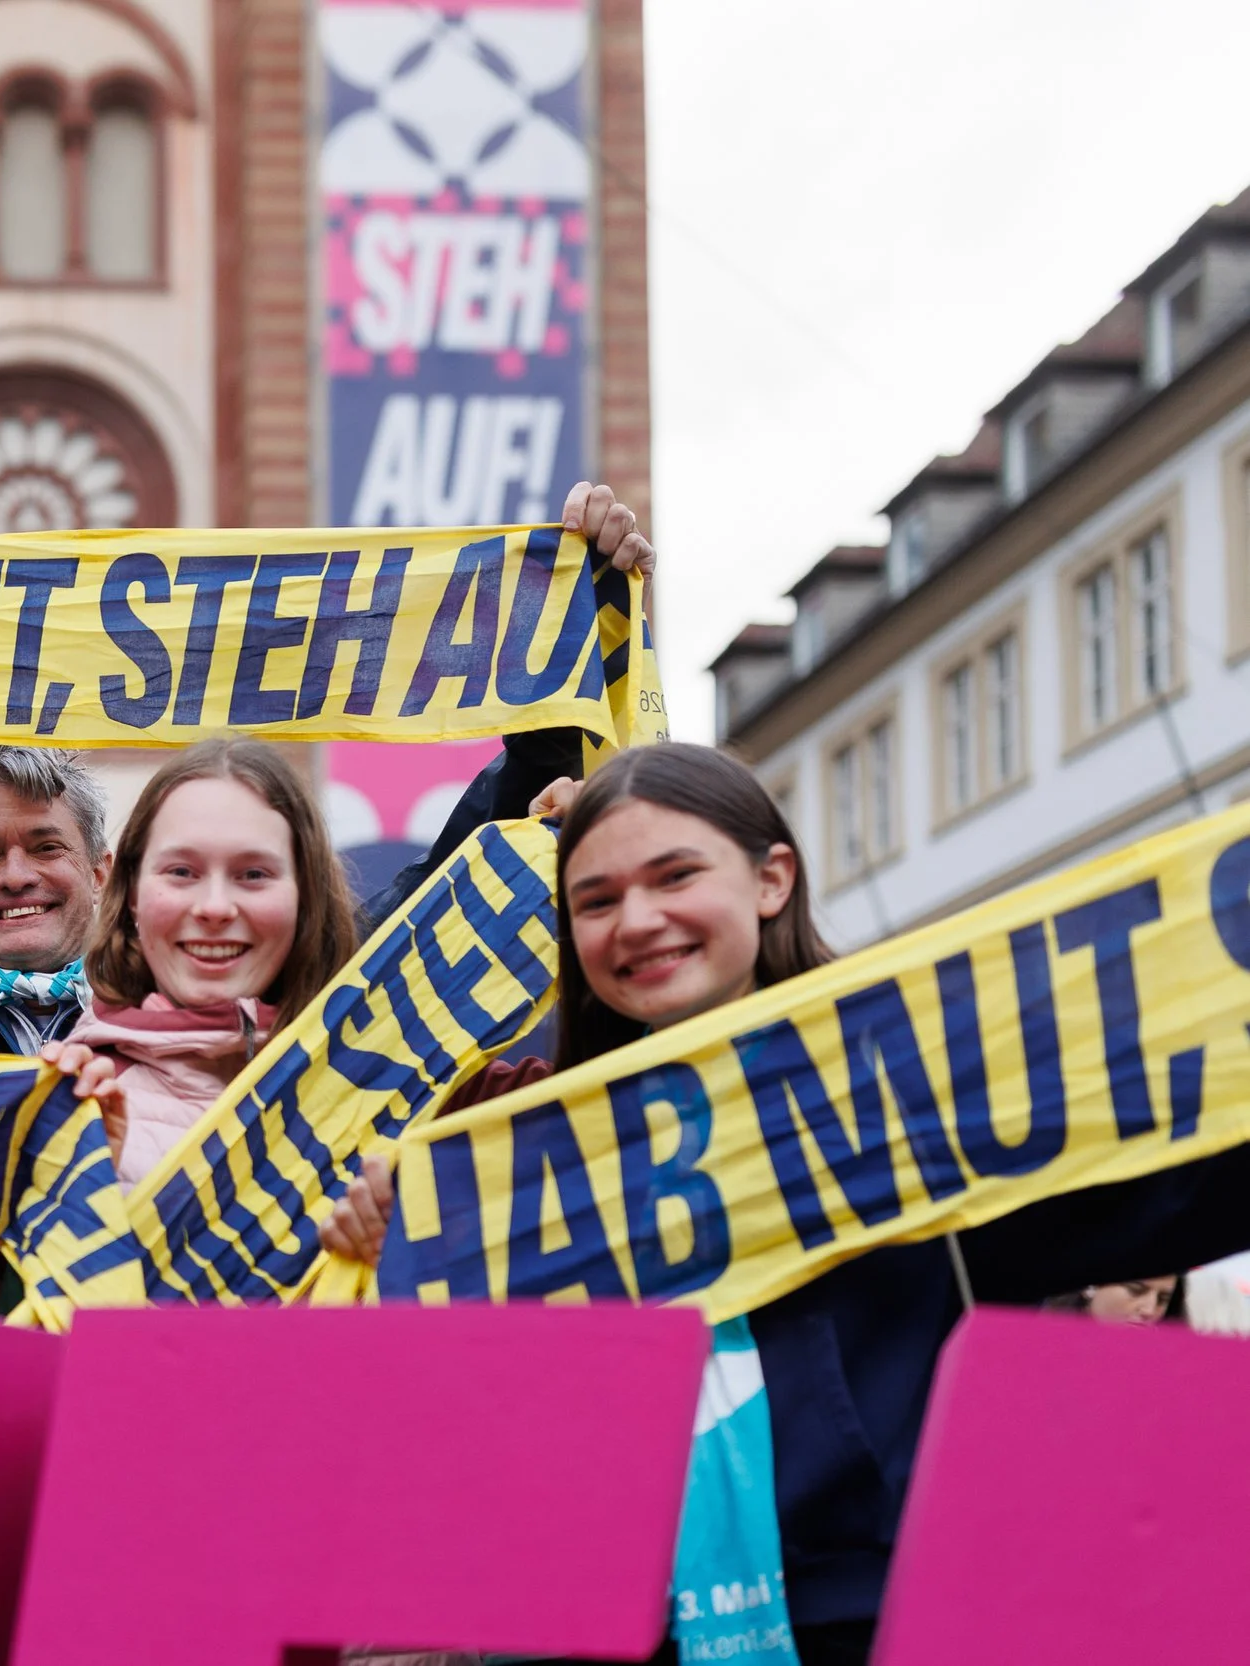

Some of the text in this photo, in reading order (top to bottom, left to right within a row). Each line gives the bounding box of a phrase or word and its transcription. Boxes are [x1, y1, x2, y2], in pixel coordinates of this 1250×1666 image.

[352, 209, 563, 354] STEH
[350, 393, 566, 526] AUF!
[99, 547, 413, 730] STEH
[323, 823, 558, 1139] STEH
[378, 1062, 732, 1304] HAB
[731, 877, 1207, 1252] MUT,
[710, 1572, 772, 1616] Mai
